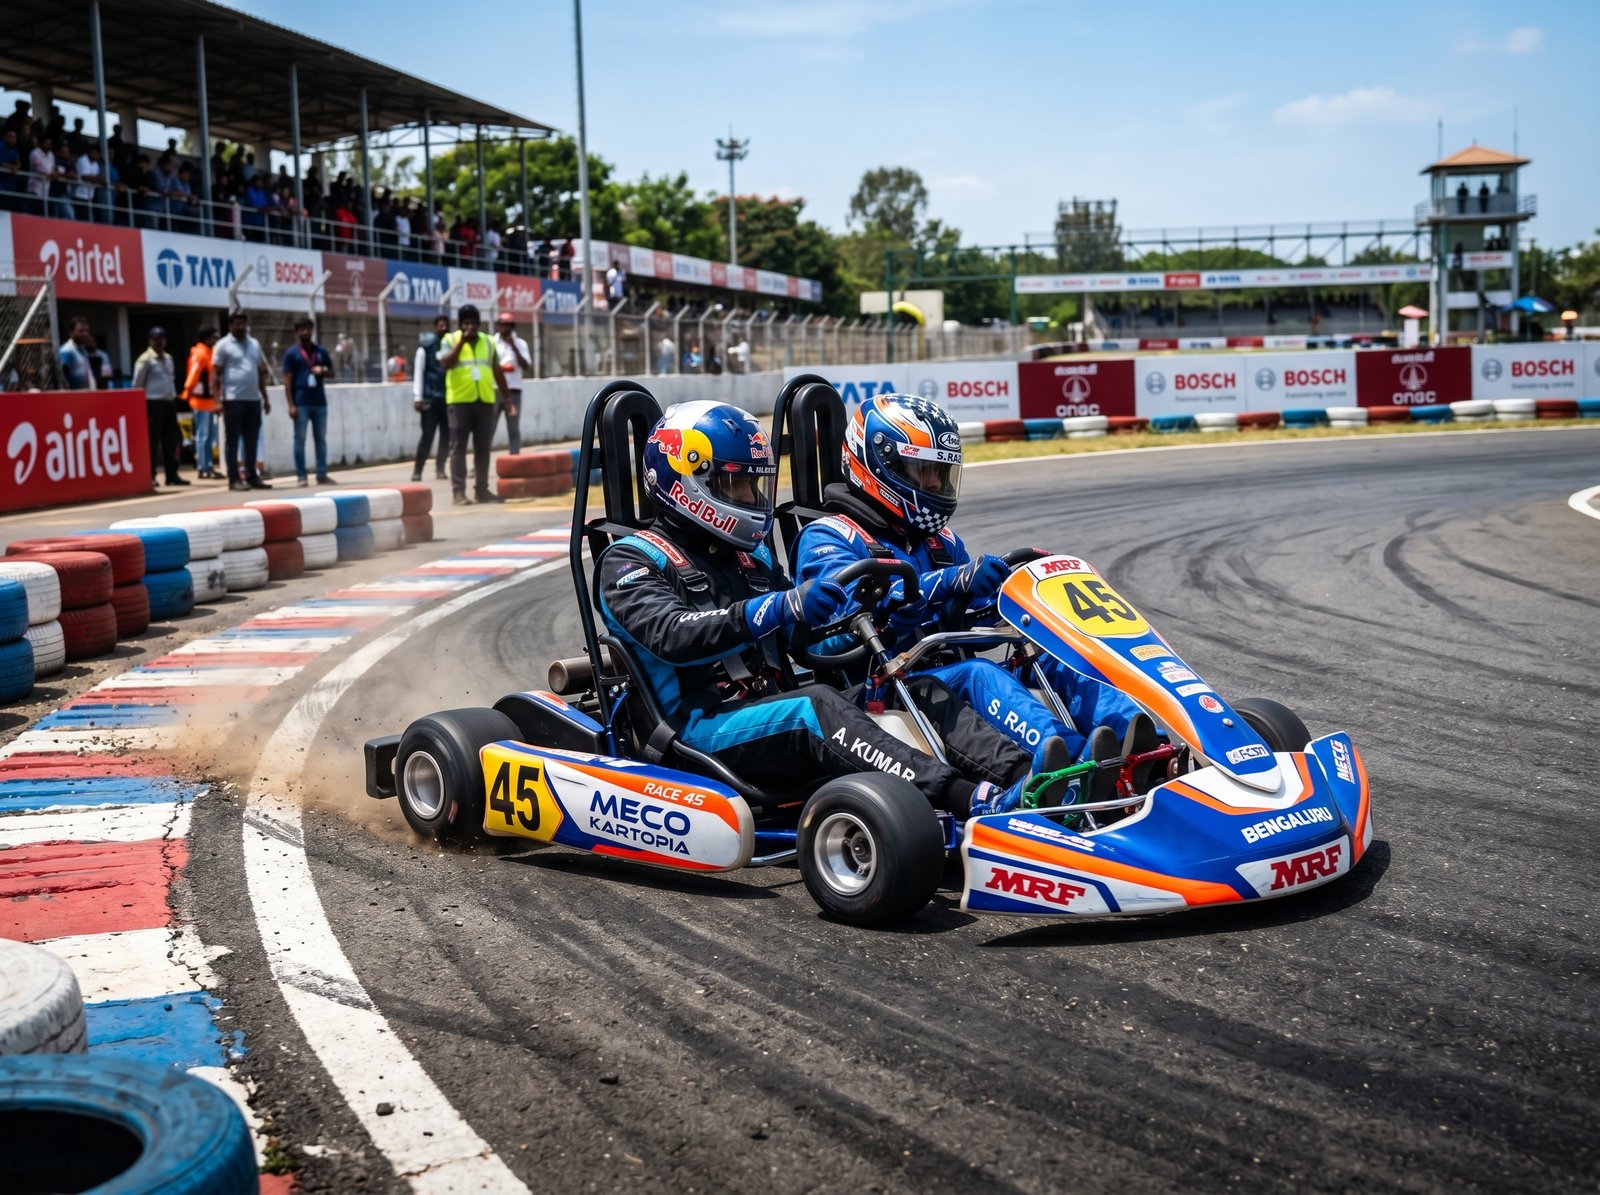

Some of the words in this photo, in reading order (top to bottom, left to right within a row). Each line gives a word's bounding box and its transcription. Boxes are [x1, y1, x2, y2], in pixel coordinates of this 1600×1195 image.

[65, 238, 124, 285] airtel
[186, 255, 236, 288] TATA
[275, 261, 313, 284] BOSCH
[1174, 372, 1236, 390] BOSCH
[1284, 369, 1346, 387] BOSCH
[1511, 359, 1575, 377] BOSCH
[946, 381, 1009, 398] BOSCH
[45, 412, 133, 482] airtel
[1041, 559, 1081, 575] MRF
[1062, 580, 1137, 623] 45
[988, 699, 1000, 720] S.
[1004, 711, 1040, 746] RAO
[831, 726, 847, 748] A.
[850, 737, 916, 782] KUMAR
[489, 761, 541, 832] 45
[589, 790, 691, 836] MECO
[643, 782, 681, 801] RACE
[684, 792, 707, 807] 45
[589, 816, 691, 856] KARTOPIA
[1240, 806, 1334, 844] BENGALURU
[985, 867, 1086, 906] MRF
[1269, 843, 1342, 891] MRF
